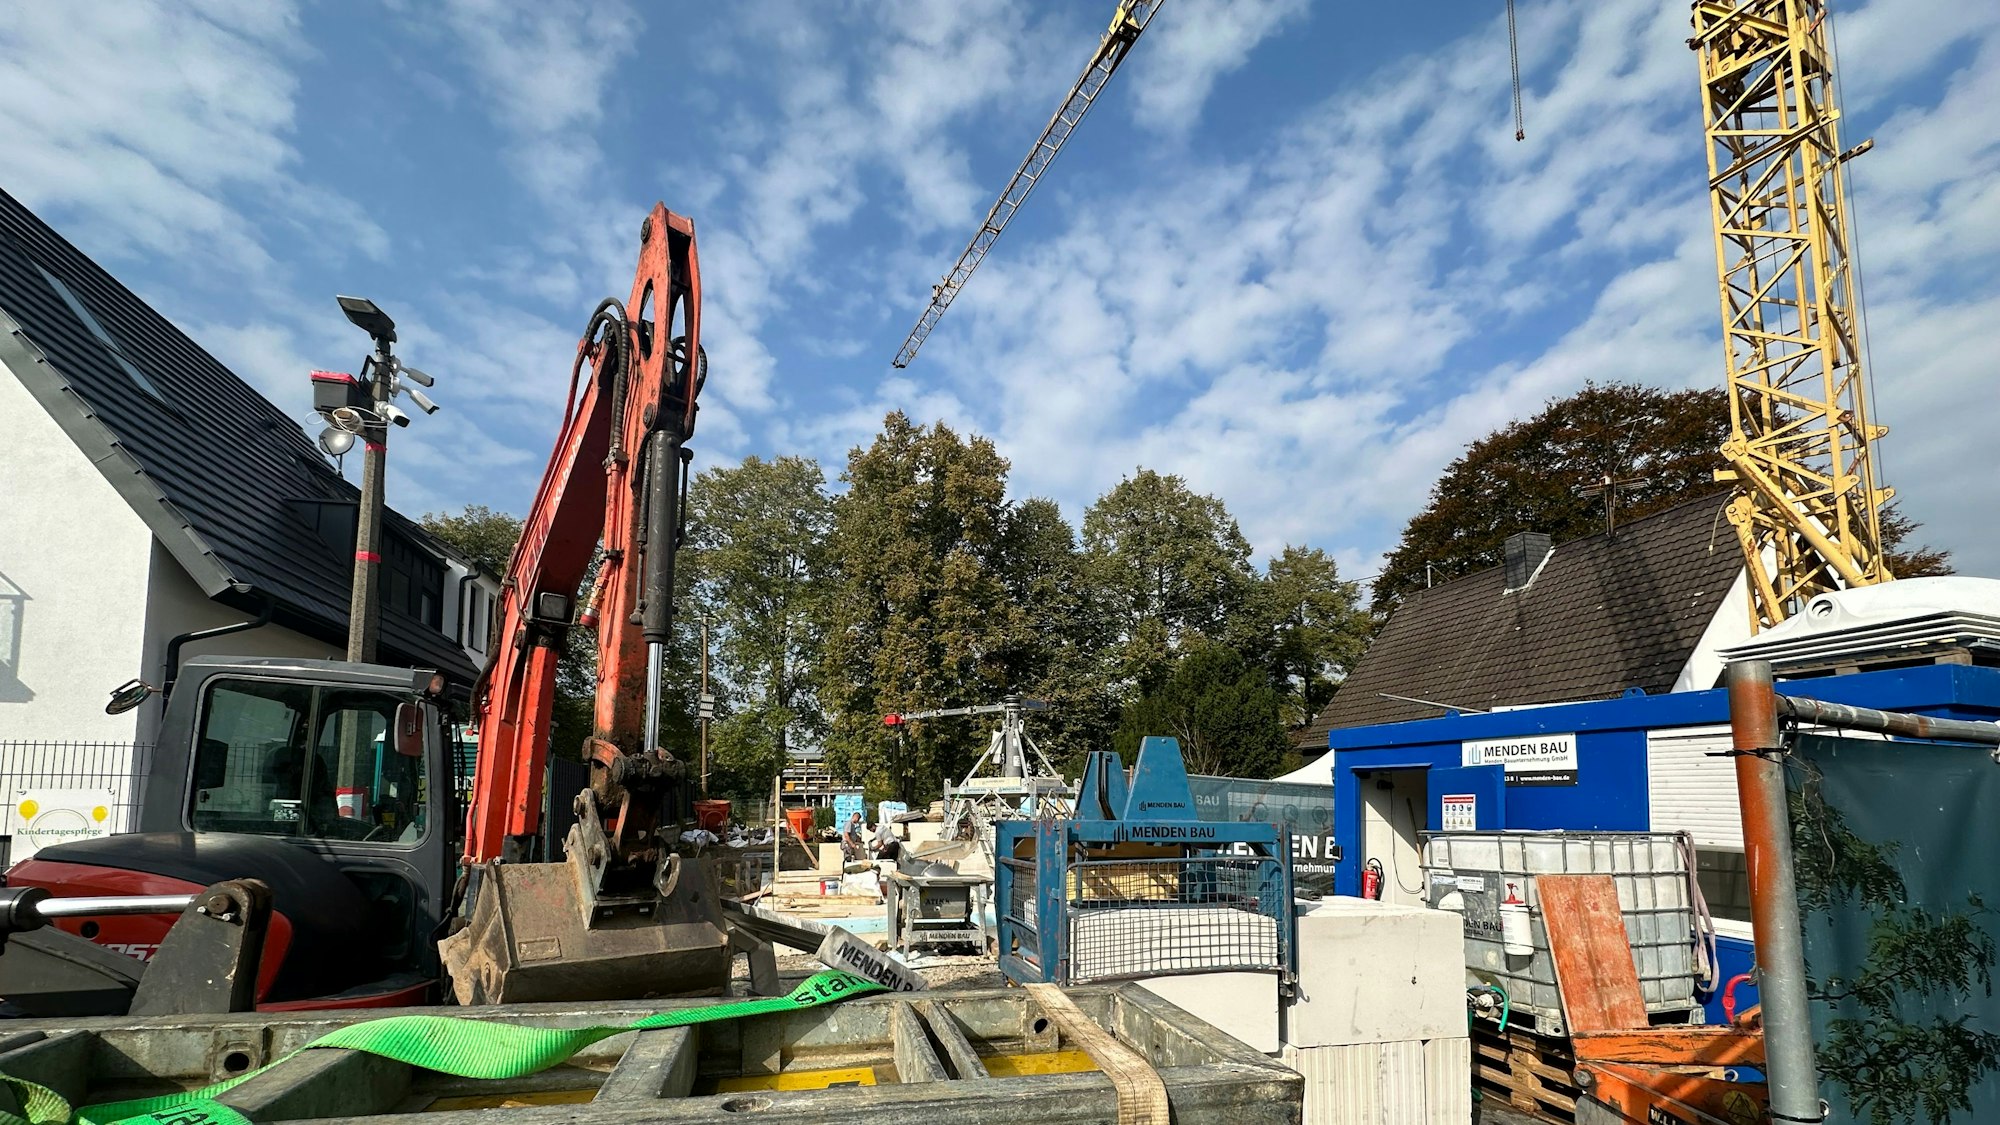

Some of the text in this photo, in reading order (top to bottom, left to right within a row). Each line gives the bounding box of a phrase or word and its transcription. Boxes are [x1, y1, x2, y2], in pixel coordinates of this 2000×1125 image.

[553, 434, 582, 507] Kubota
[1484, 741, 1568, 757] MENDEN BAU
[1147, 801, 1173, 809] MENDEN
[1195, 794, 1220, 806] BAU
[17, 827, 103, 837] Kindertagespflege
[1132, 826, 1215, 838] MENDEN BAU
[836, 940, 903, 991] MENDEN
